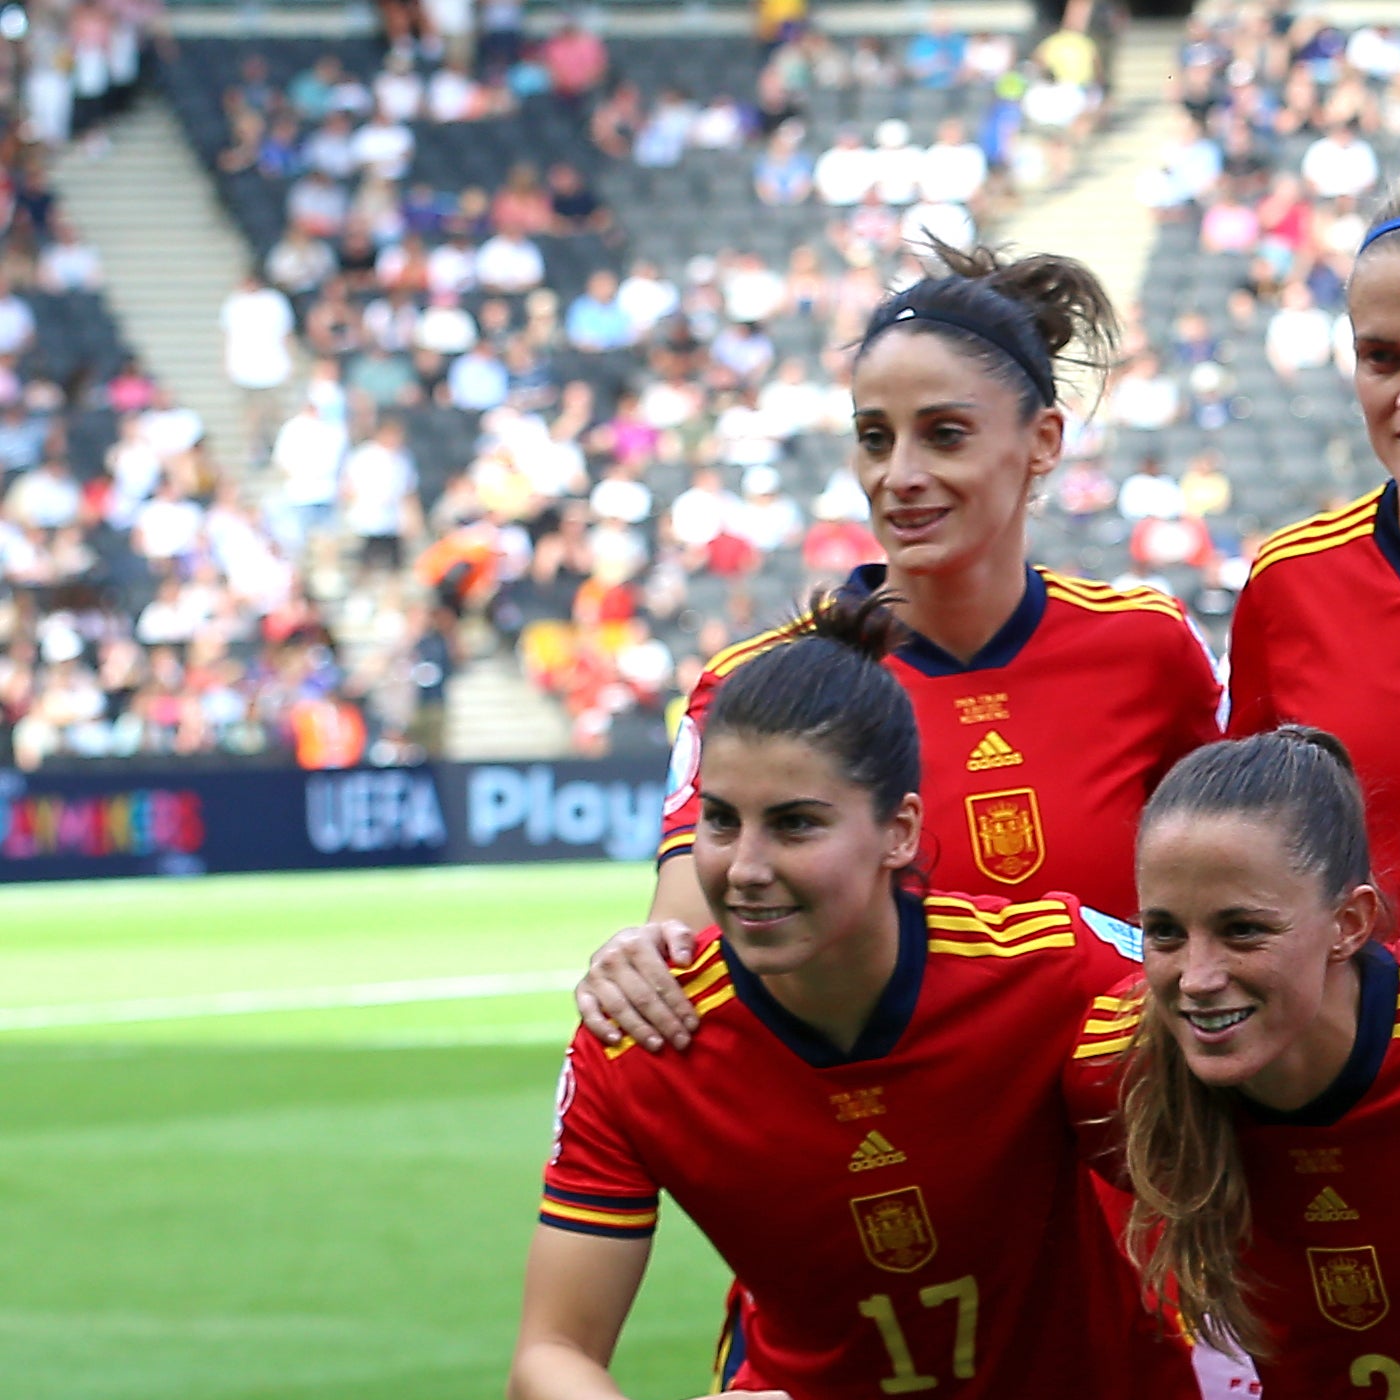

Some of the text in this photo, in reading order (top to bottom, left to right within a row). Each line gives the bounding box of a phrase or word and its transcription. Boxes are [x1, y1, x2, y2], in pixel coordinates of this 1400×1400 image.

[966, 752, 1024, 772] adidas
[307, 773, 448, 854] UEFA
[848, 1151, 907, 1171] adidas
[1304, 1208, 1360, 1221] adidas
[857, 1274, 979, 1395] 17
